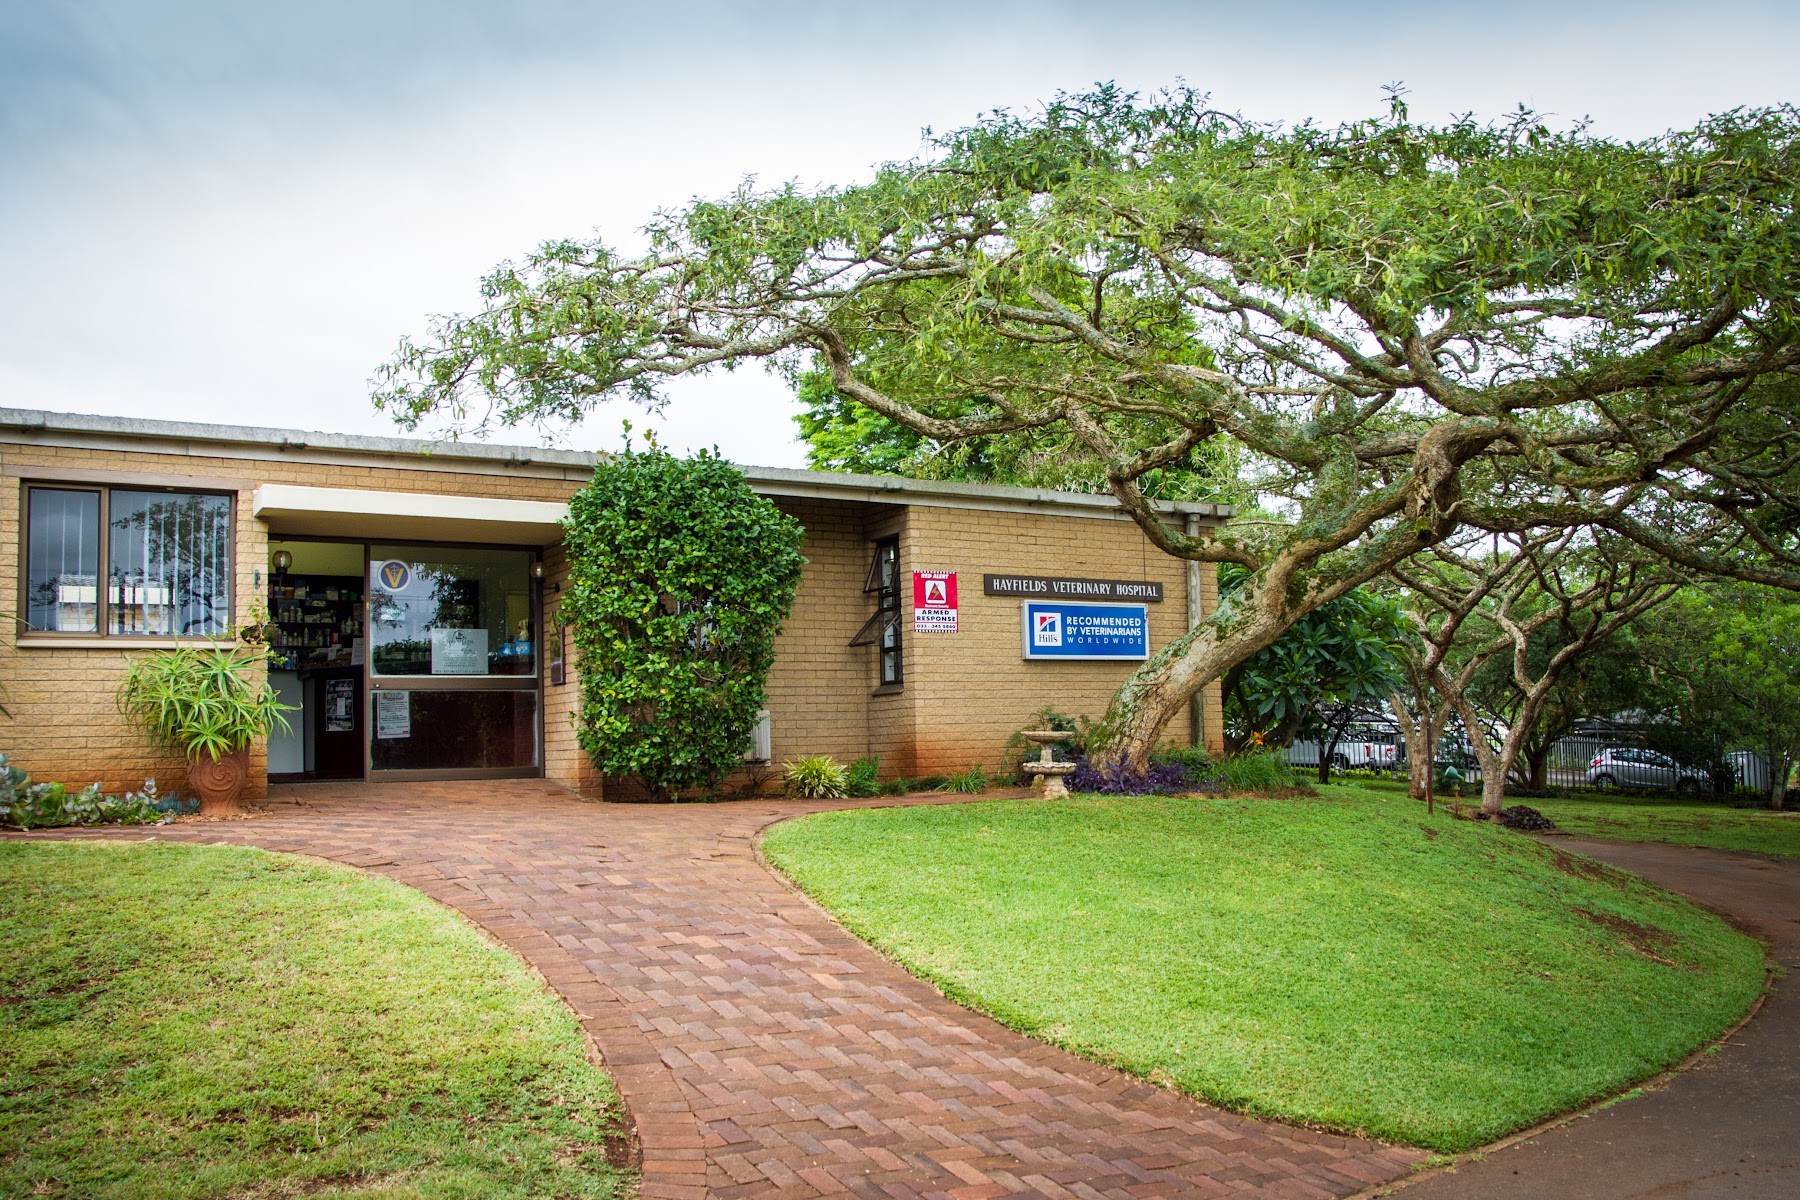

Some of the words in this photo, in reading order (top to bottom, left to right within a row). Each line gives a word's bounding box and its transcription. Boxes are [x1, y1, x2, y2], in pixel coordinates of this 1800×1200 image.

[993, 578, 1048, 592] HAYFIELDS
[1052, 581, 1112, 595] VETERINARY
[1116, 584, 1158, 597] HOSPITAL
[1066, 616, 1141, 626] RECOMMENDED
[1066, 627, 1078, 635] BY
[1080, 627, 1142, 636] VETERINARIANS
[1038, 634, 1058, 643] Hill's
